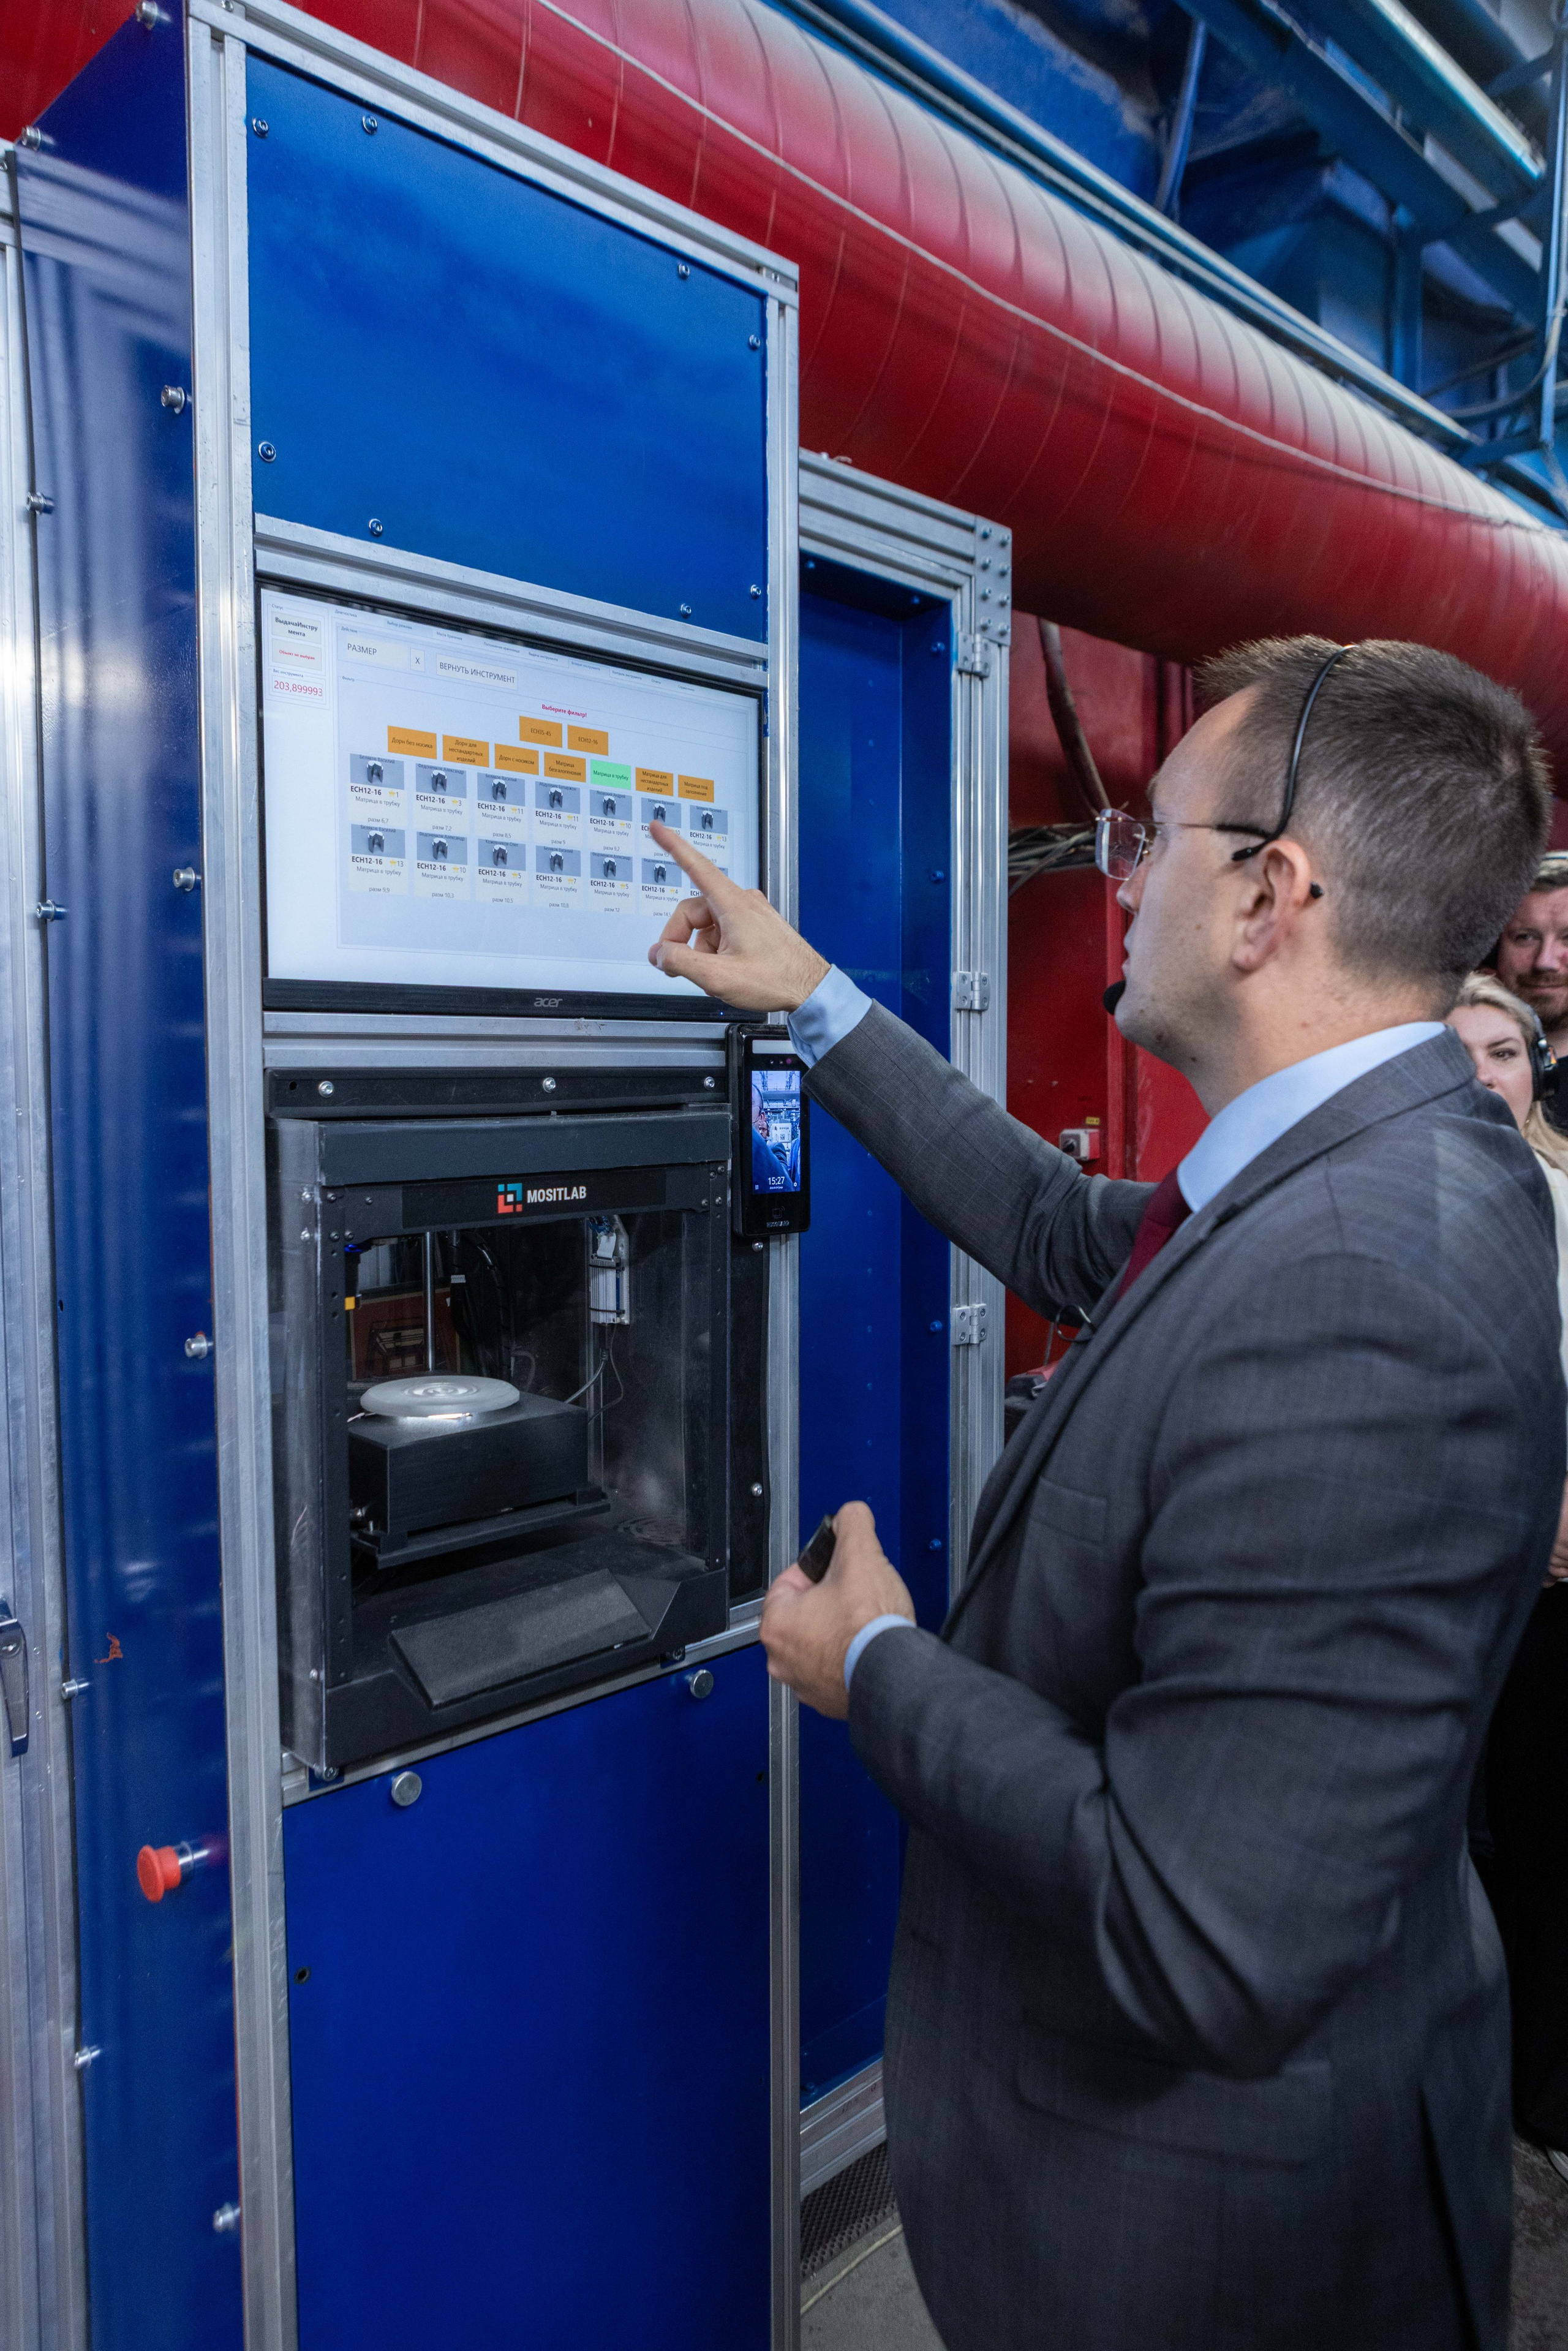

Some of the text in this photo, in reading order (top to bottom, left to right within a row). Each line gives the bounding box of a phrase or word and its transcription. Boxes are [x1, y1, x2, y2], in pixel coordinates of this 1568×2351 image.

[275, 617, 317, 631] ВыдачаИнстру
[347, 643, 377, 655] РАЗМЕР
[440, 662, 515, 683] ВЕРНУТЬ ИНСТРУМЕНТ
[274, 680, 322, 696] 203,899993
[542, 704, 587, 718] Выберите фильтр!
[449, 747, 483, 757] нестандартных
[549, 767, 581, 776] безгалогеновая
[534, 998, 562, 1007] acer
[527, 1186, 586, 1203] MOSITLAB
